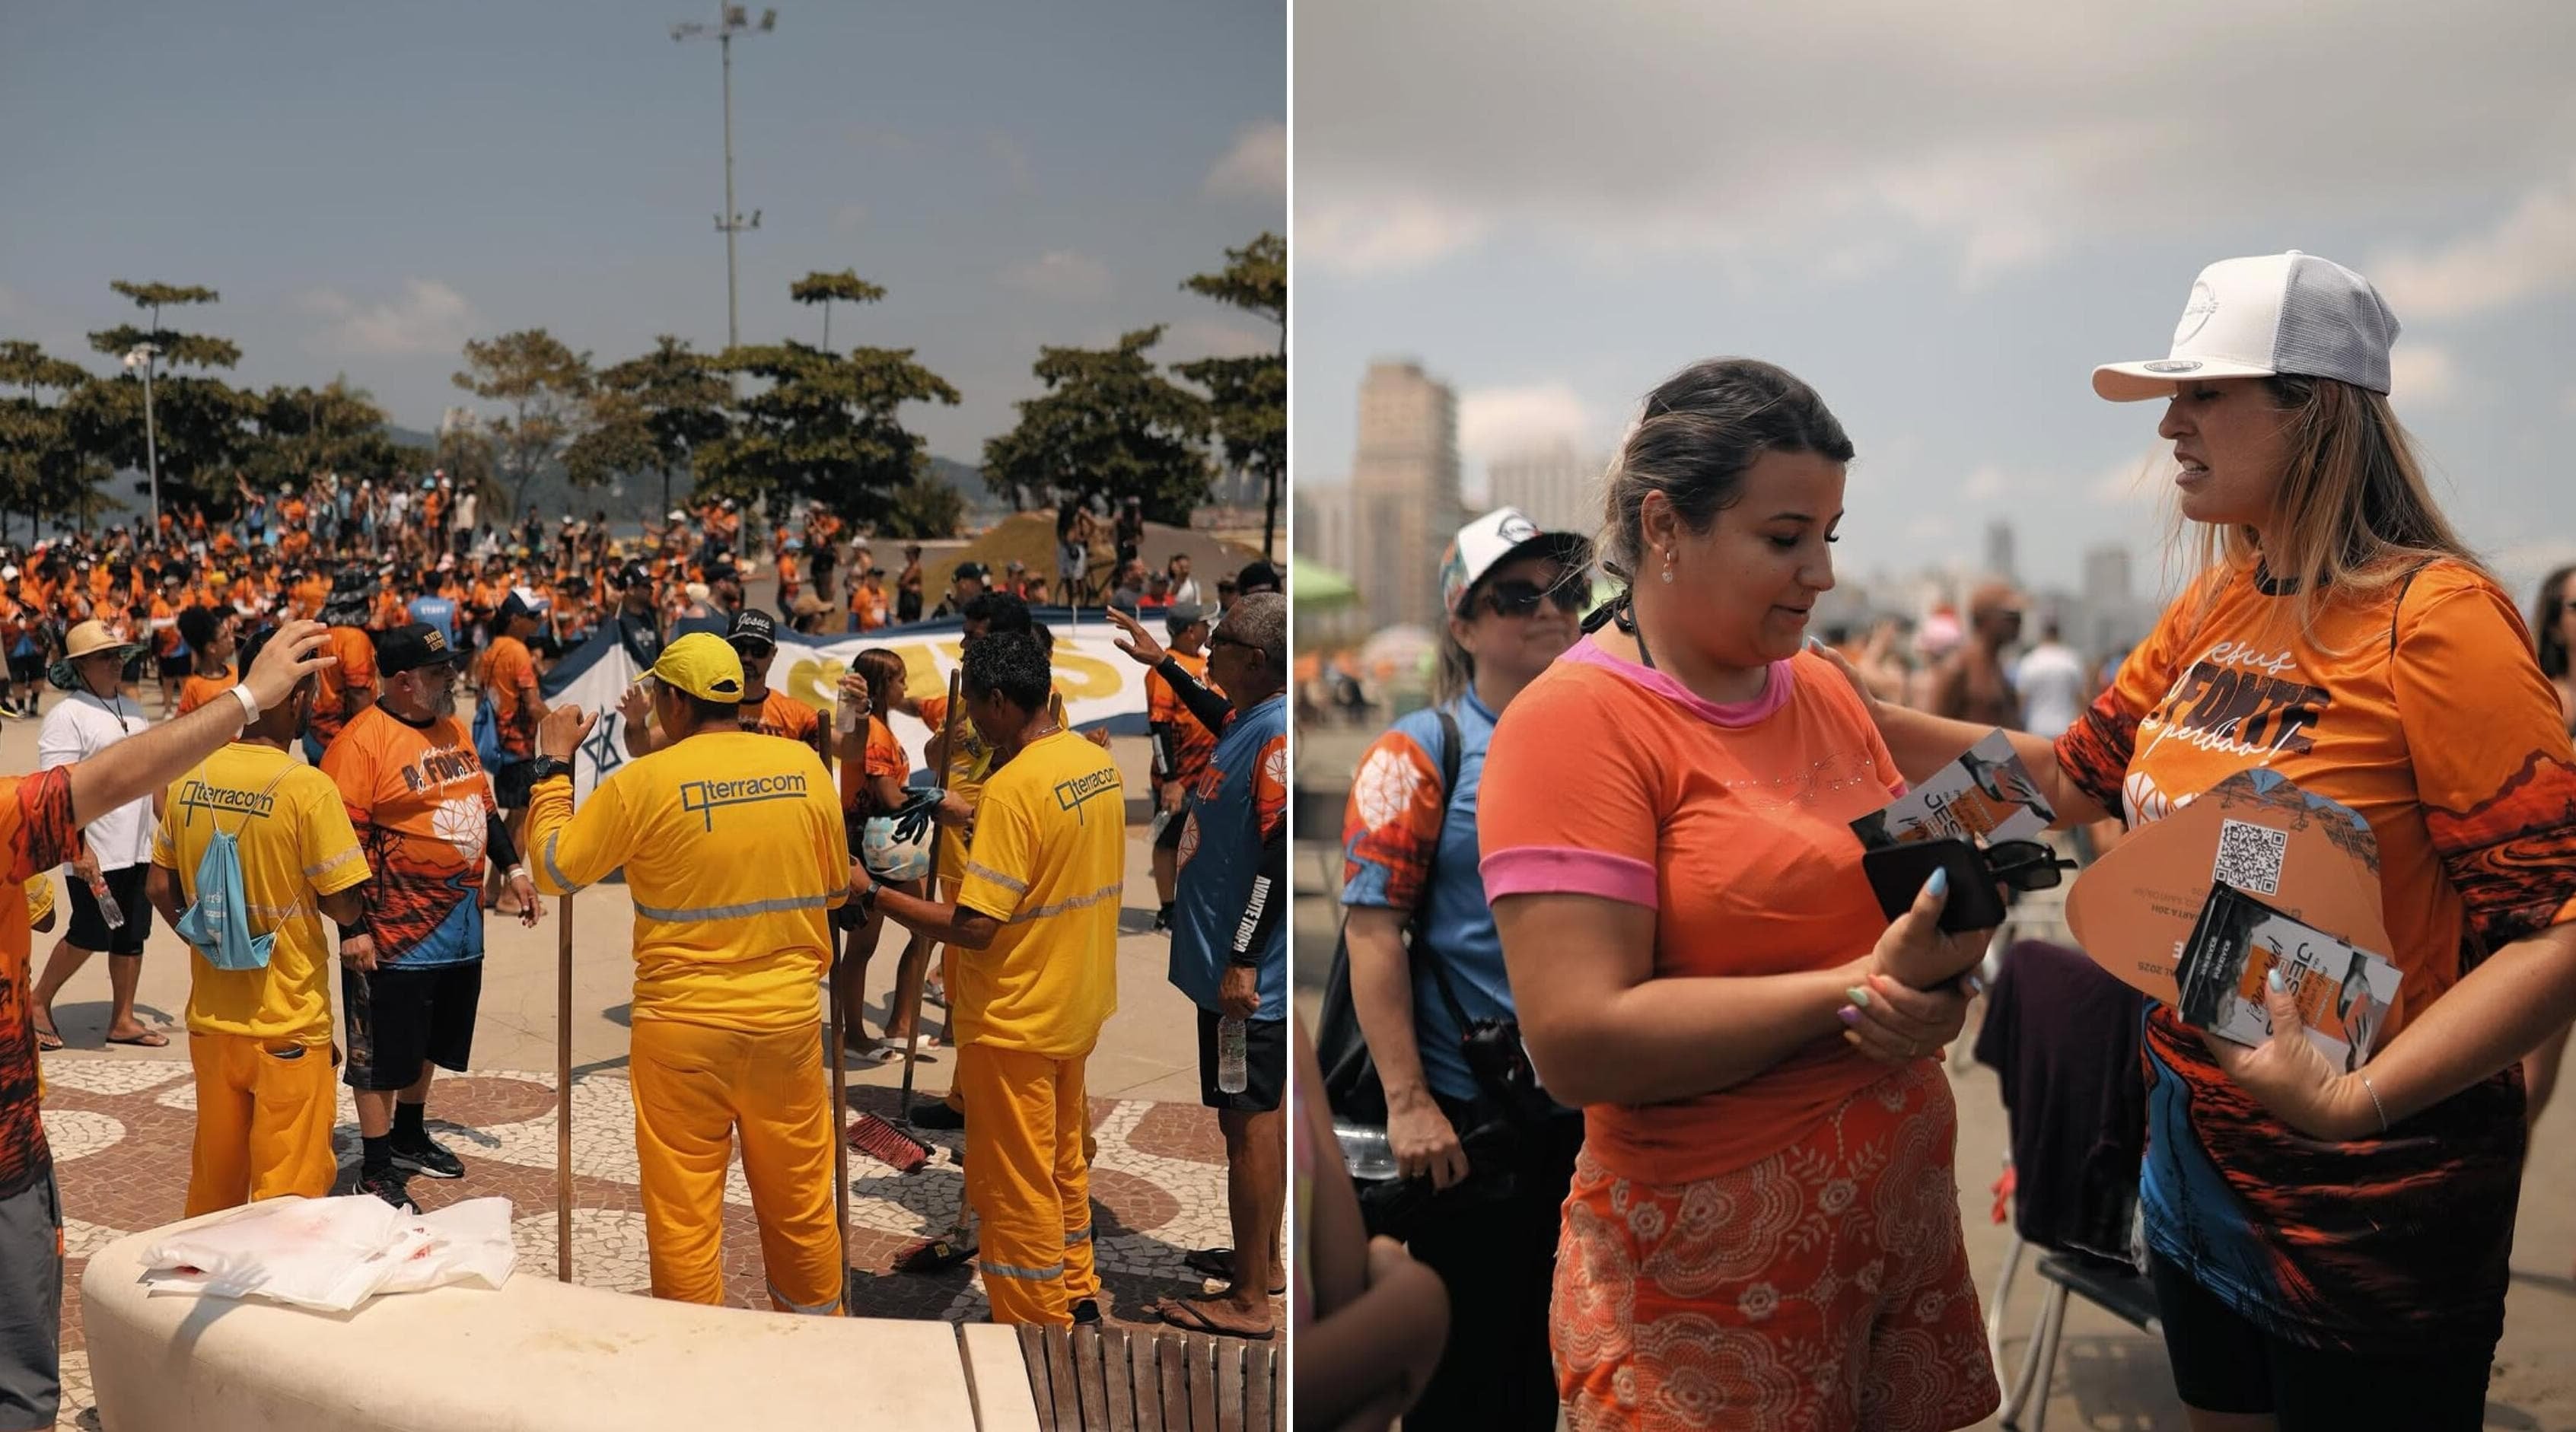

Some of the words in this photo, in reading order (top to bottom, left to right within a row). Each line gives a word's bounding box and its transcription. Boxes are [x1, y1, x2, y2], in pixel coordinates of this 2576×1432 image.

[736, 612, 770, 632] Jesus
[707, 773, 807, 800] terracom
[1245, 874, 1272, 919] AVANTE
[1233, 915, 1259, 953] TROPA
